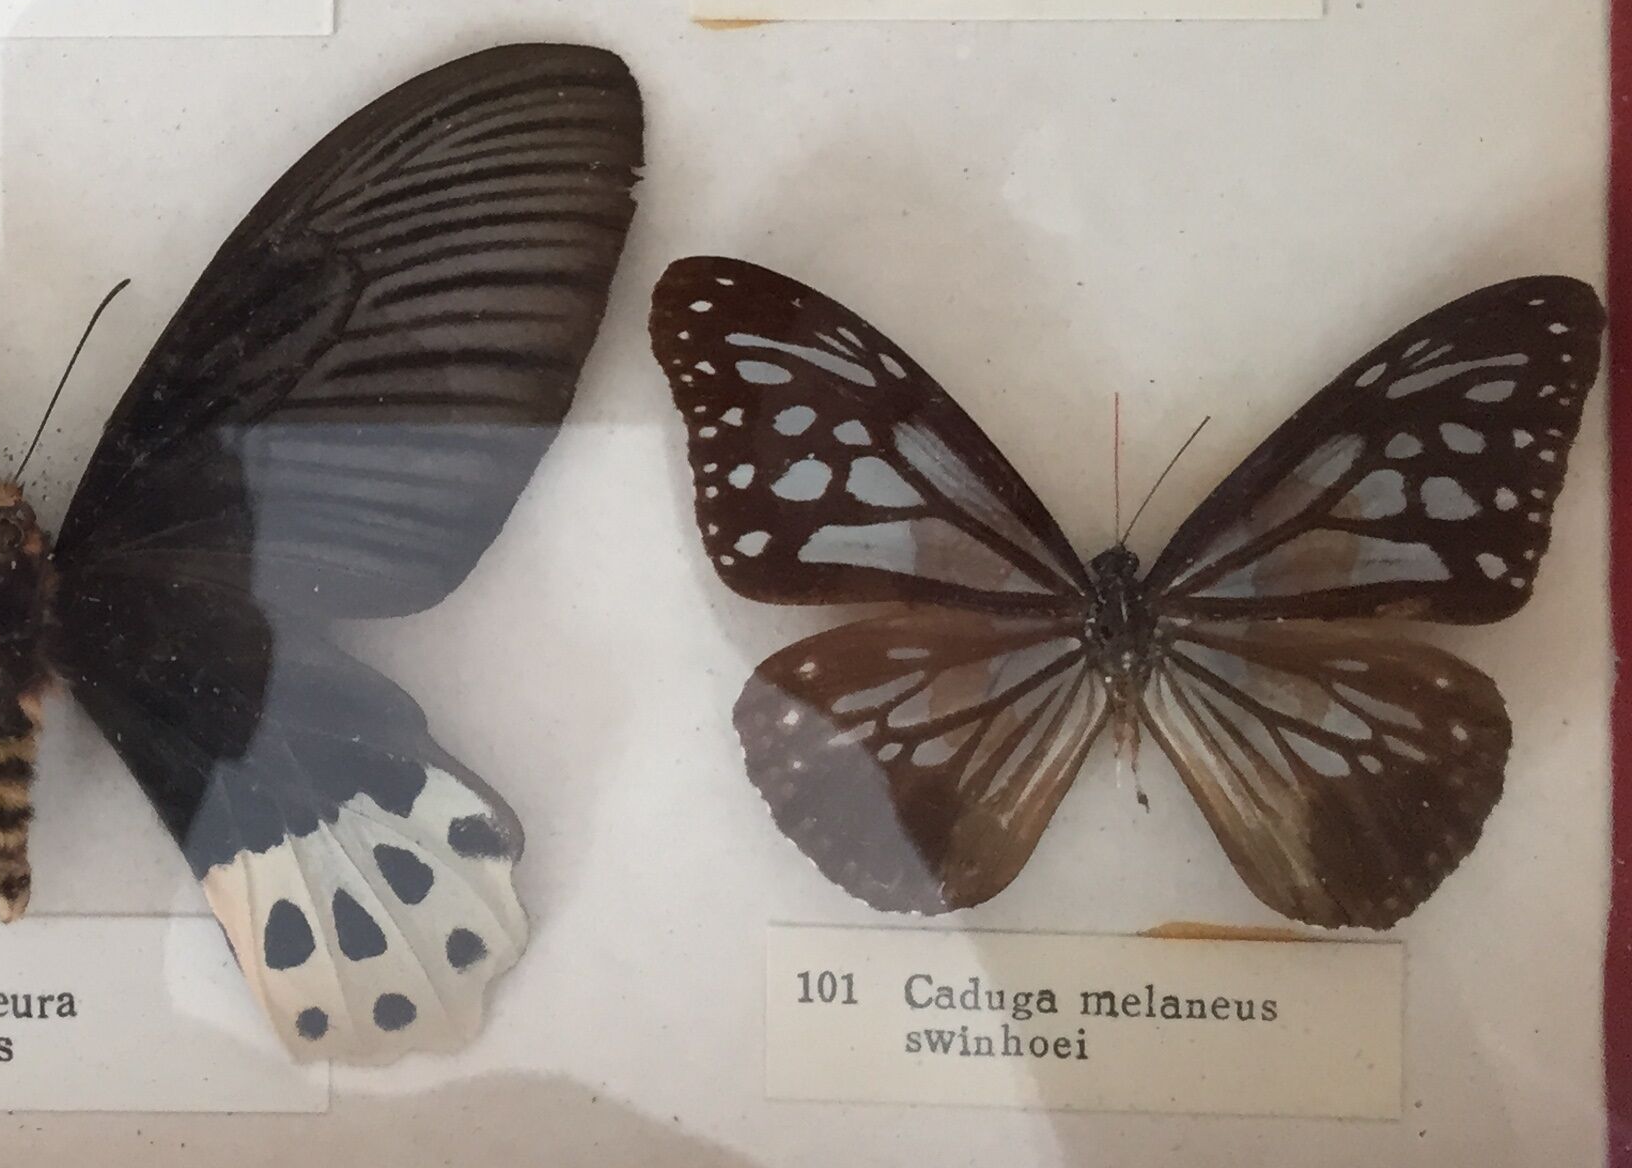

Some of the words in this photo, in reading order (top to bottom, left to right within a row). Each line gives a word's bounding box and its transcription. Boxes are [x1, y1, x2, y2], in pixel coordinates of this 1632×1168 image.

[796, 970, 858, 1005] 101
[903, 973, 1059, 1021] Caduga
[1079, 983, 1279, 1022] melaneus
[904, 1023, 1090, 1061] swinhoei
